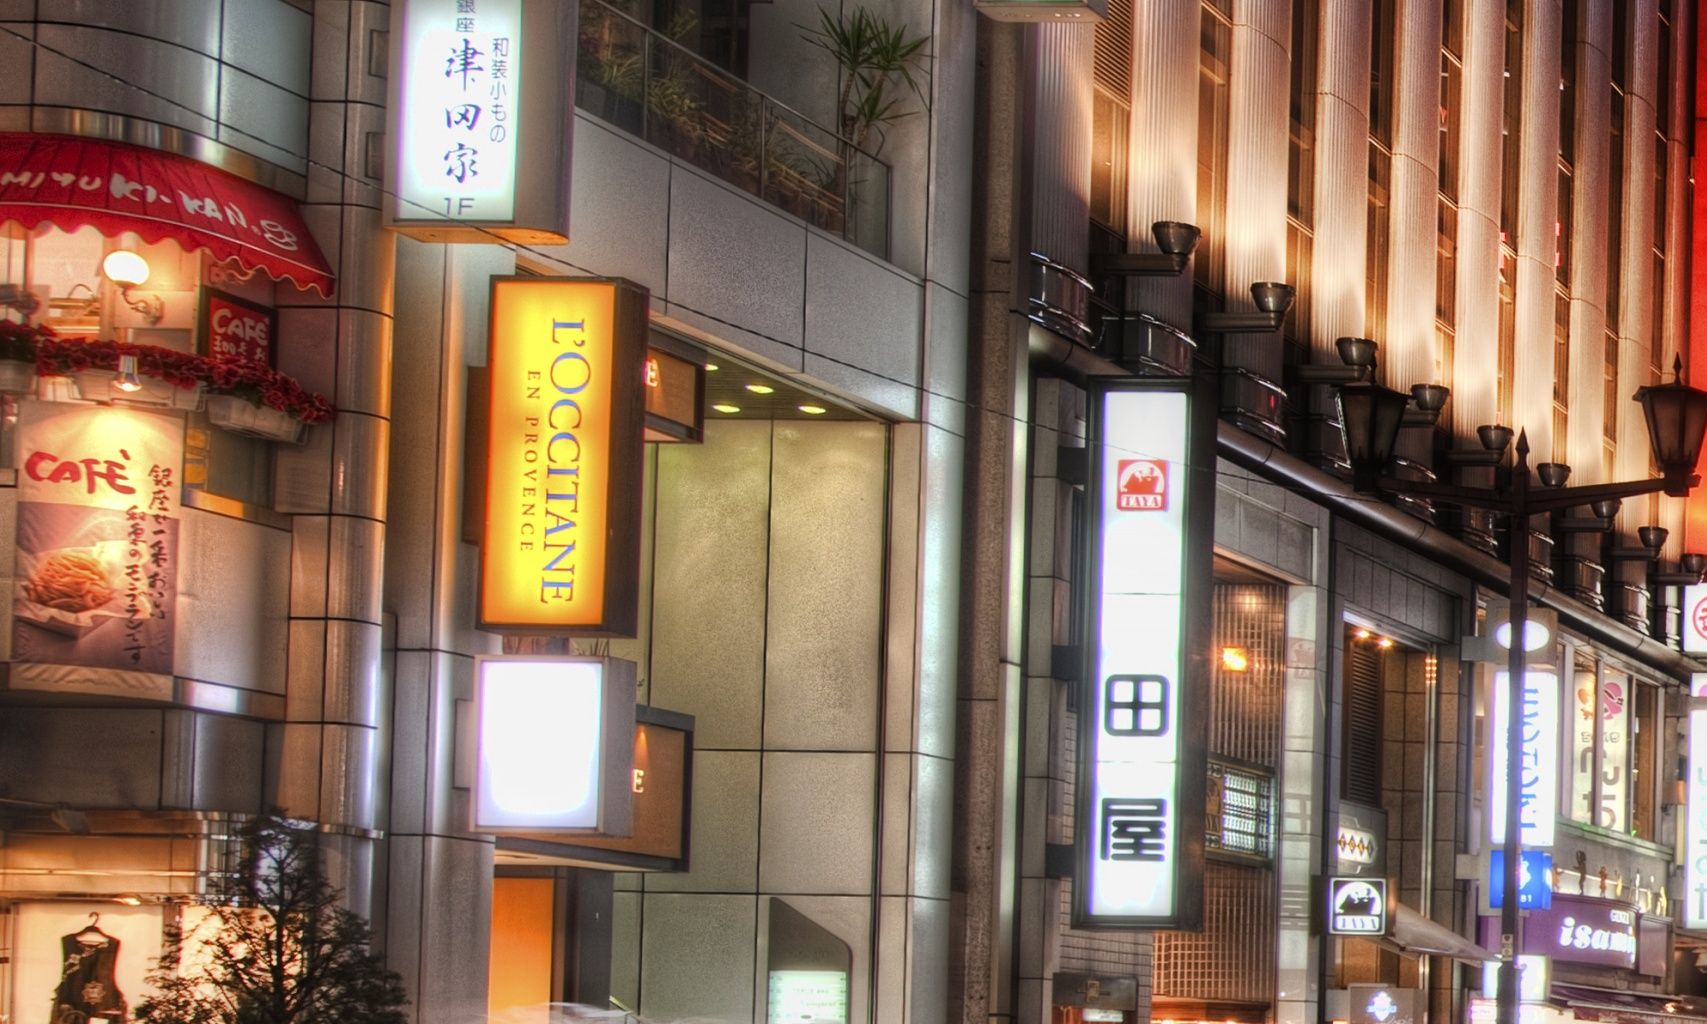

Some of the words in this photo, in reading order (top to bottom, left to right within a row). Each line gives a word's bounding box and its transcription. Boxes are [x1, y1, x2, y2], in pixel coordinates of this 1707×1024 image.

[489, 37, 509, 143] 和装小もの
[443, 197, 475, 215] 1F
[526, 370, 541, 399] EN
[520, 416, 539, 551] PROVENCE
[1121, 494, 1161, 508] TAYA
[1100, 674, 1170, 862] 田屋
